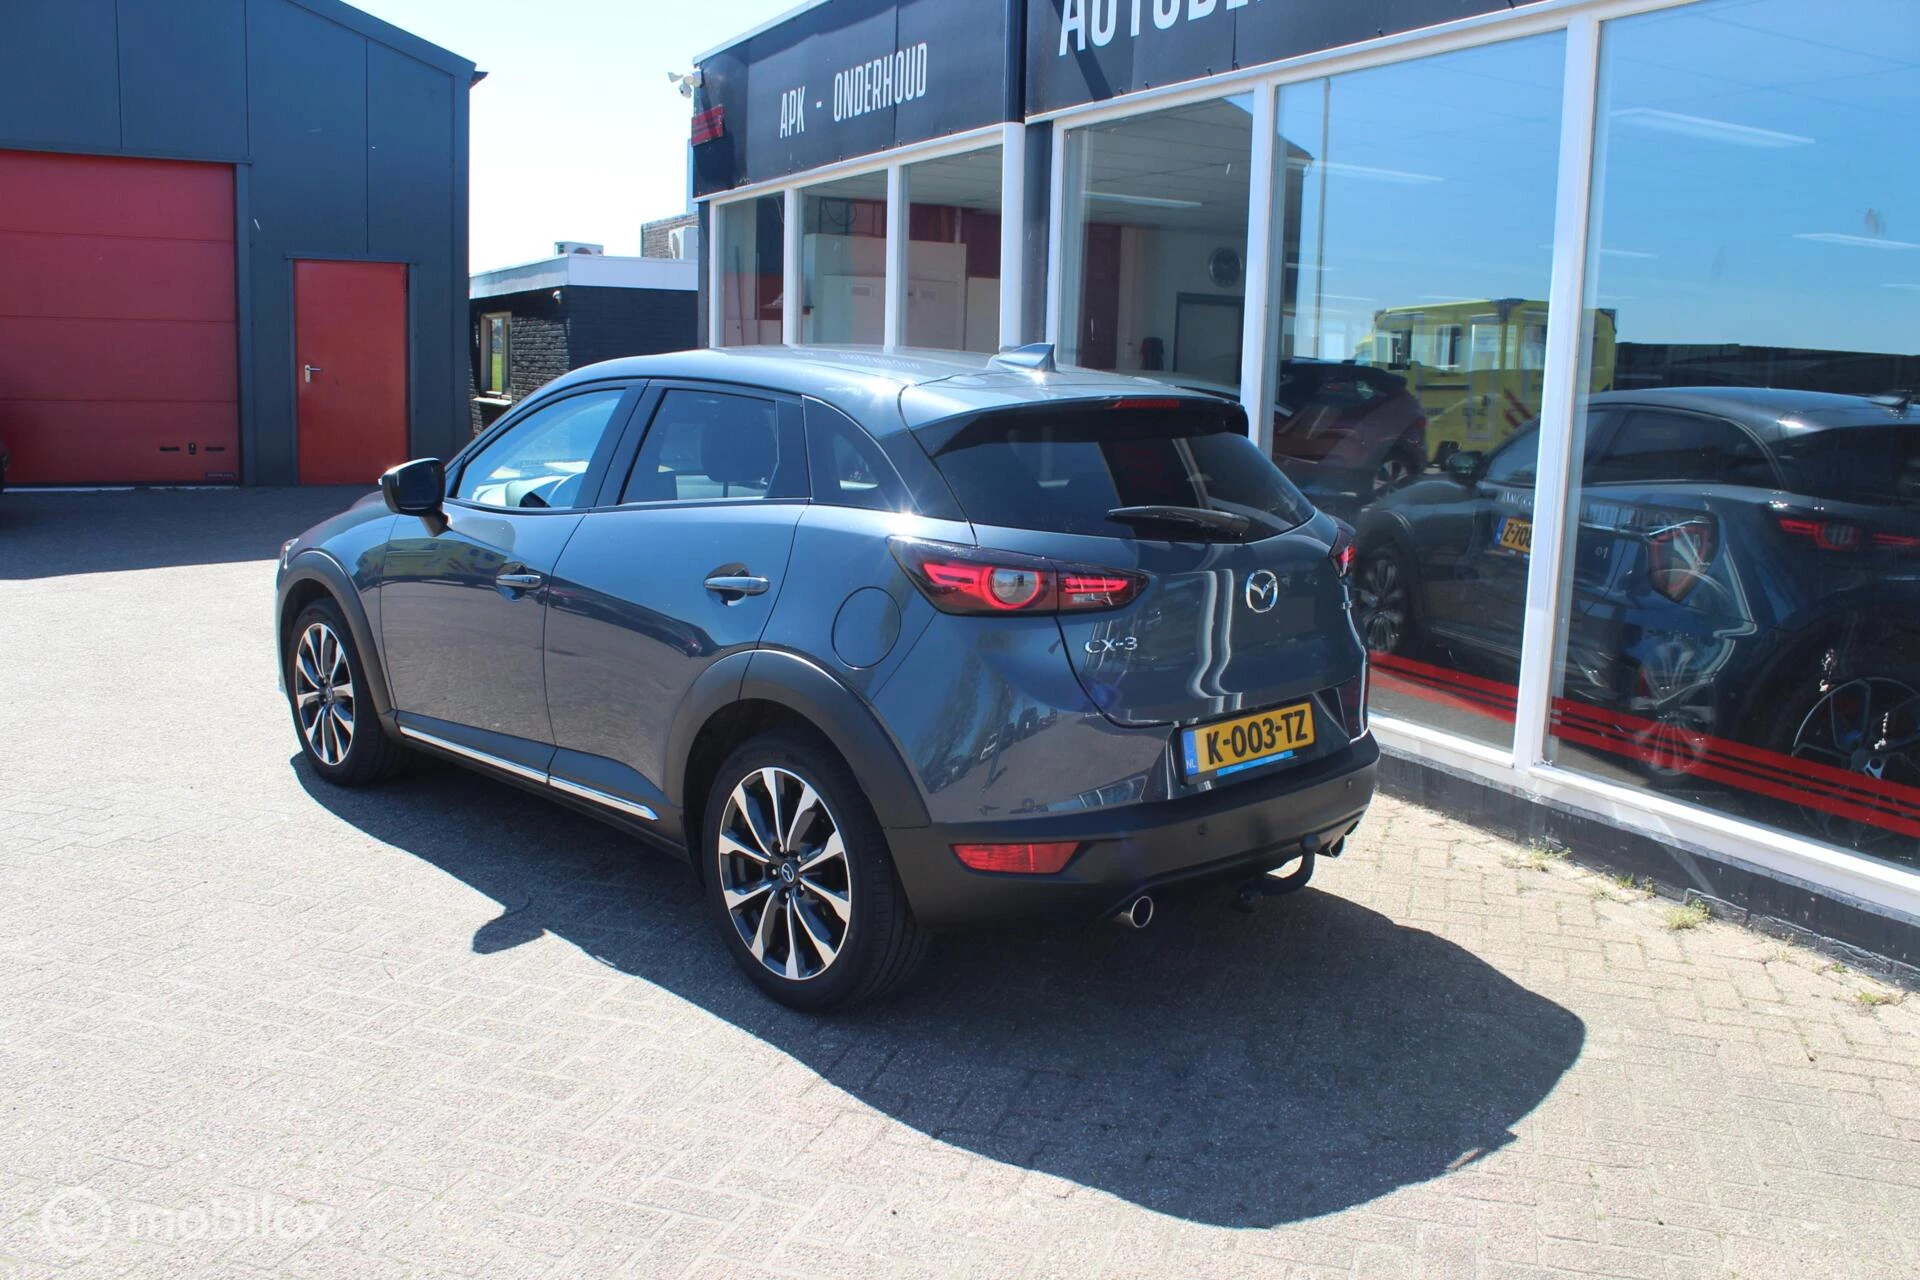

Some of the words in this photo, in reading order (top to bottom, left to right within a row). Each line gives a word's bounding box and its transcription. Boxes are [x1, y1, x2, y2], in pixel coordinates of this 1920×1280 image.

[780, 85, 806, 139] APK
[833, 43, 928, 122] ONDERHOUD
[1085, 636, 1138, 653] CX-3
[1206, 709, 1308, 765] K-003-TZ
